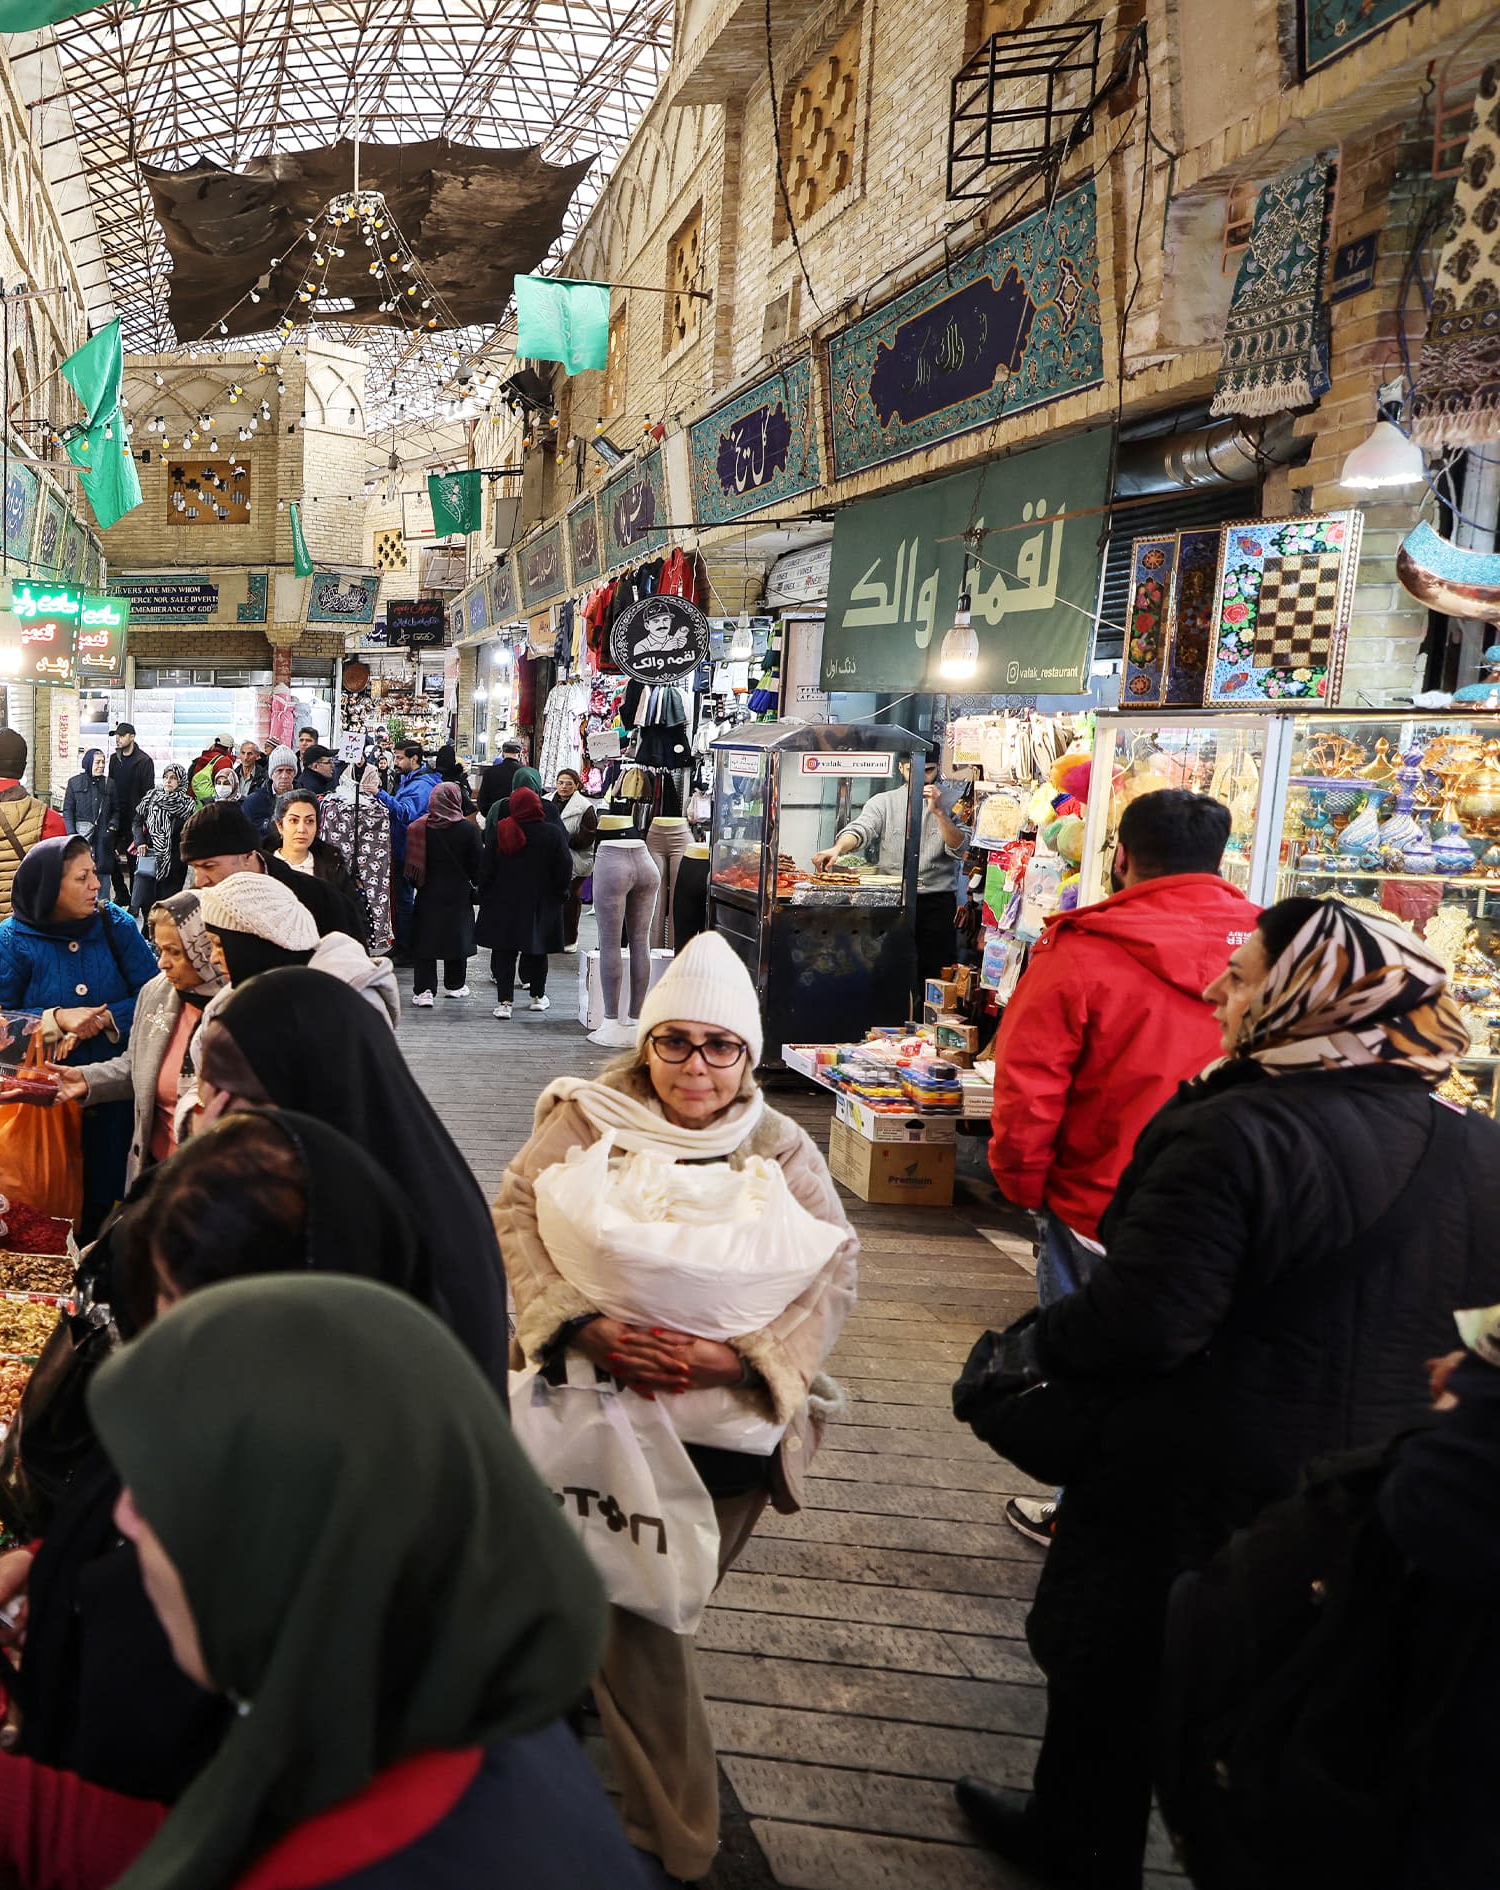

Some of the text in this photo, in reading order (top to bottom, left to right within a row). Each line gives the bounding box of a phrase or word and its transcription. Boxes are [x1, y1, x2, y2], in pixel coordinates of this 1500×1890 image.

[841, 499, 1066, 649] لقمه والک
[144, 586, 160, 594] ARE
[161, 586, 177, 594] MEN
[153, 596, 168, 604] NOR
[128, 605, 186, 613] EMEMBERANCE
[187, 605, 197, 613] OF
[632, 650, 696, 670] لقمه والک
